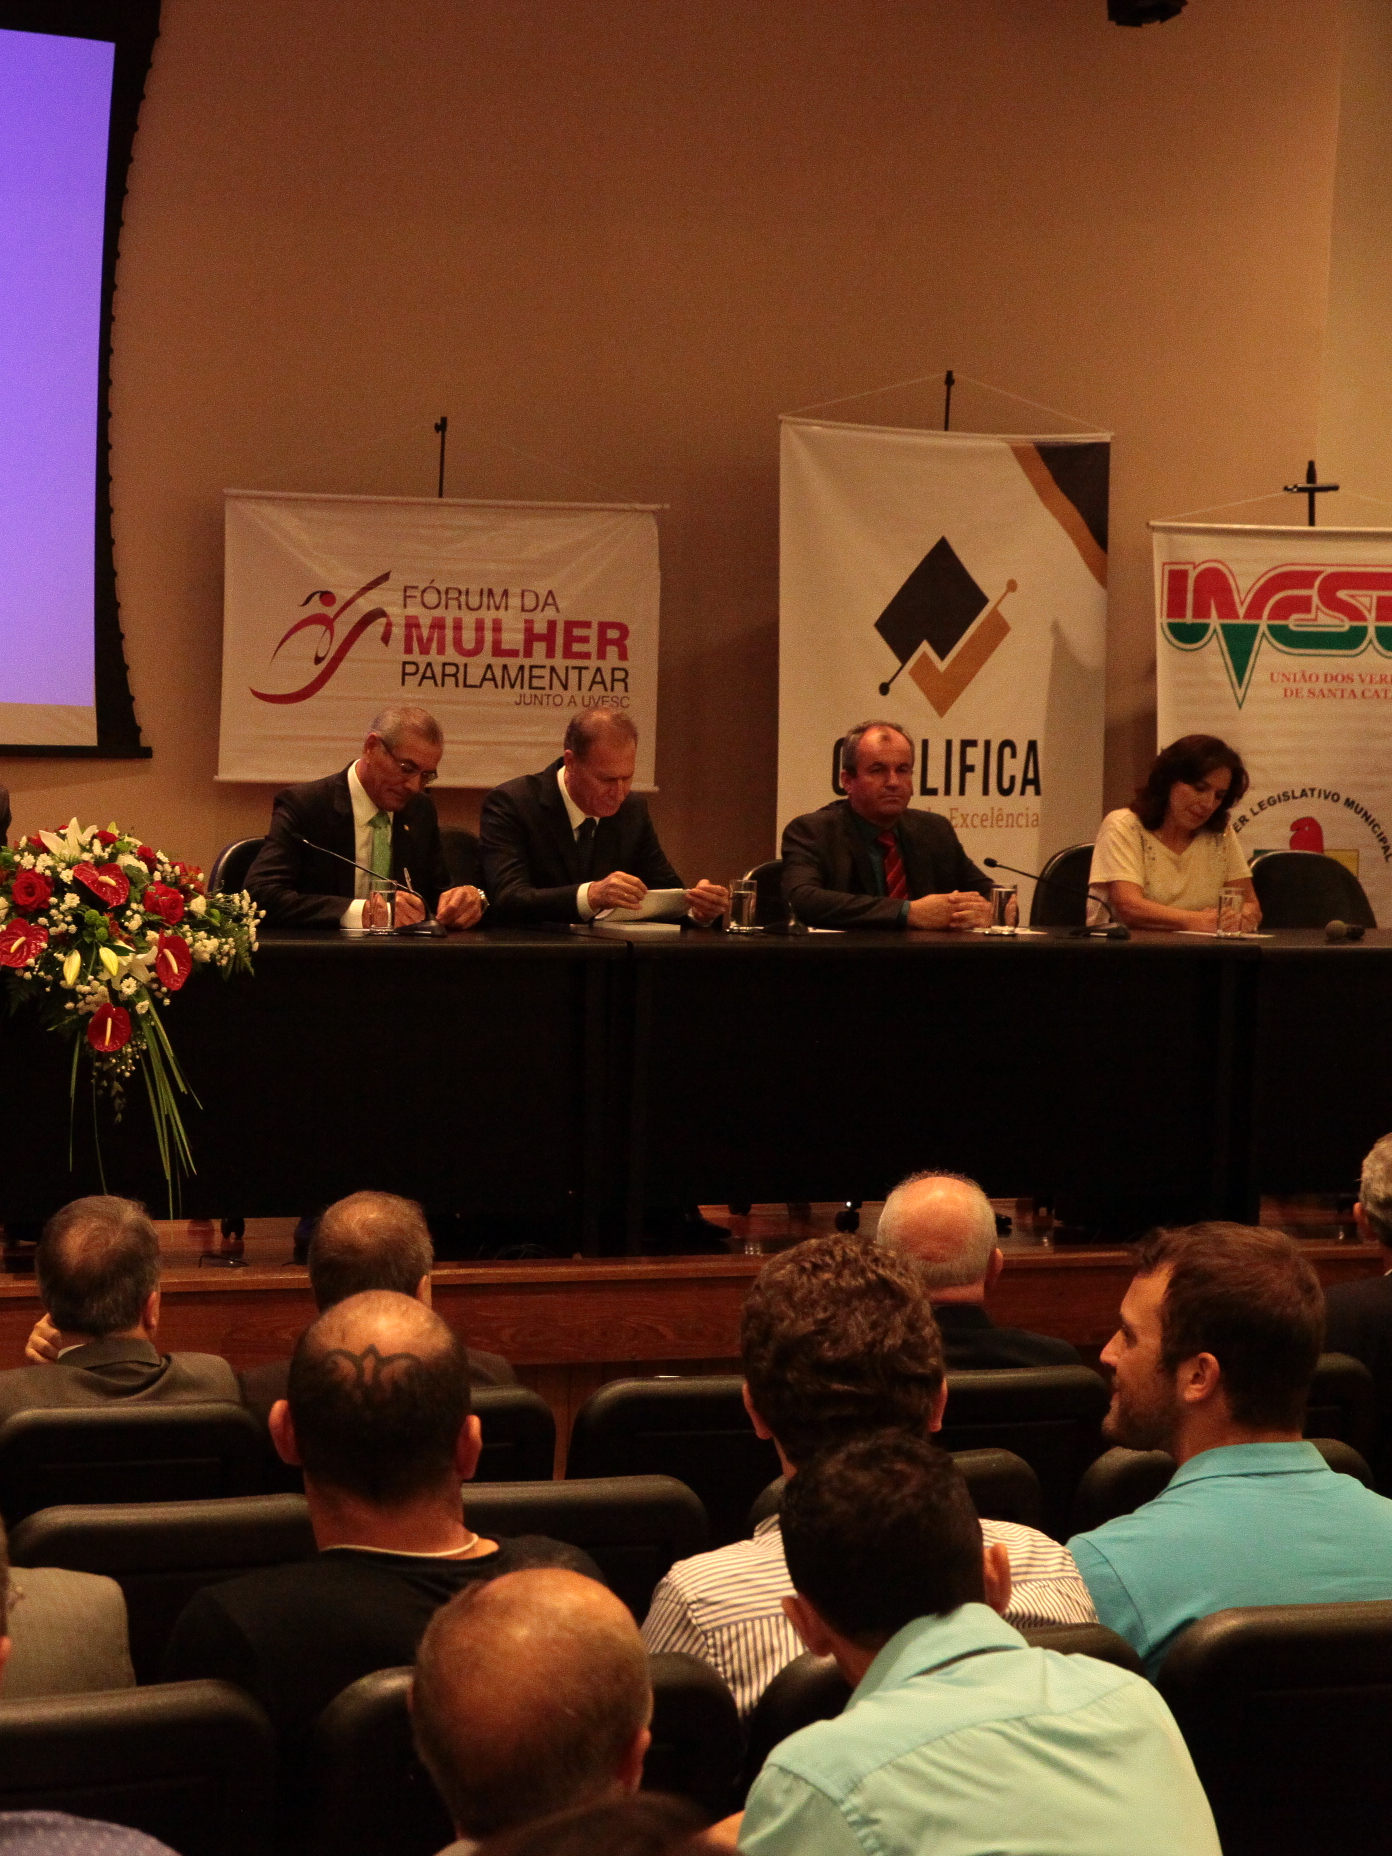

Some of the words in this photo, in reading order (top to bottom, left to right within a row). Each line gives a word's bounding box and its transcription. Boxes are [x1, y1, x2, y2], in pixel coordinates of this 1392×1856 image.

[402, 579, 509, 612] FÓRUM
[520, 589, 561, 613] DA
[402, 614, 630, 662] MULHER
[400, 660, 630, 693] PARLAMENTAR
[1270, 669, 1320, 684] UNIÃO
[1323, 672, 1355, 684] DOS
[514, 693, 564, 707] JUNTO
[567, 694, 577, 707] A
[581, 695, 630, 708] UVESC
[1283, 687, 1305, 699] DE
[1307, 687, 1358, 699] SANTA
[948, 806, 1041, 829] Excelência
[1249, 787, 1341, 817] LEGISLATIVO
[1343, 797, 1392, 863] MUNICIPAL
